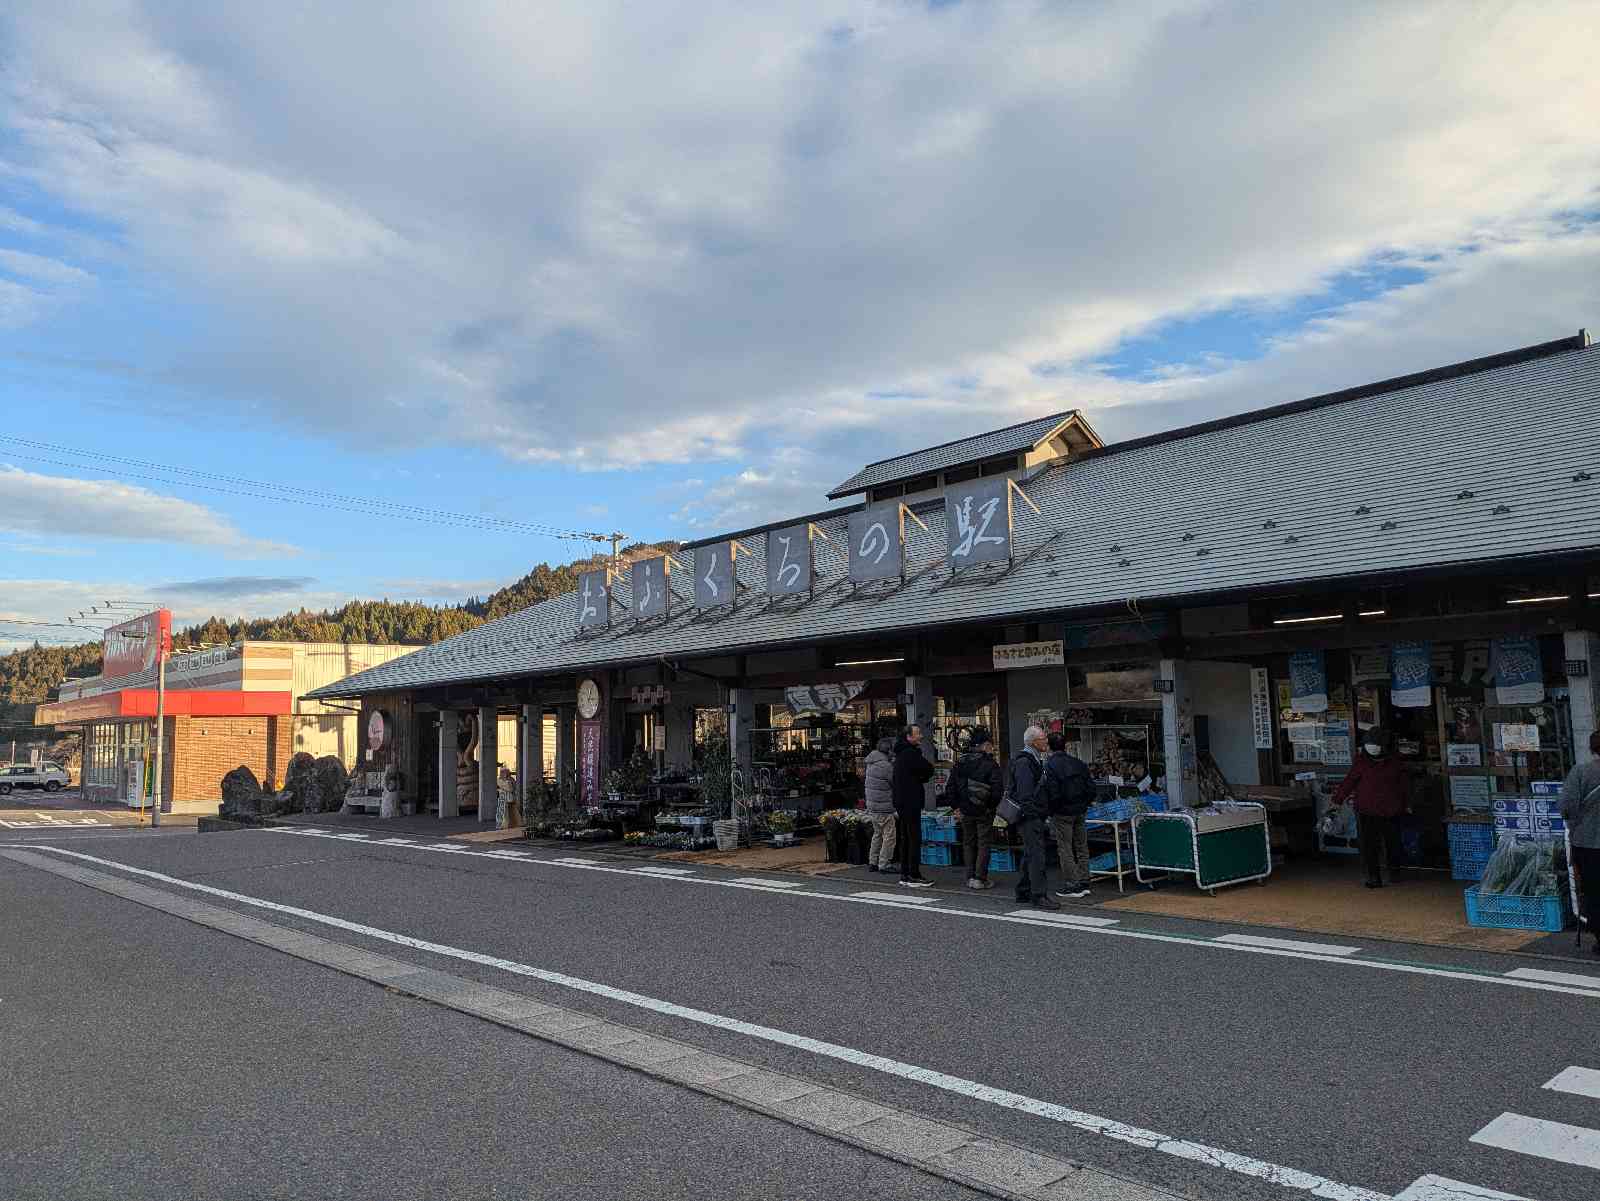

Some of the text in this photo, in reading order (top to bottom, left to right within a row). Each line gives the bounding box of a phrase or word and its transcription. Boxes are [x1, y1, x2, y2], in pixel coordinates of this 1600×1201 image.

[580, 495, 1005, 623] おふくろの駅
